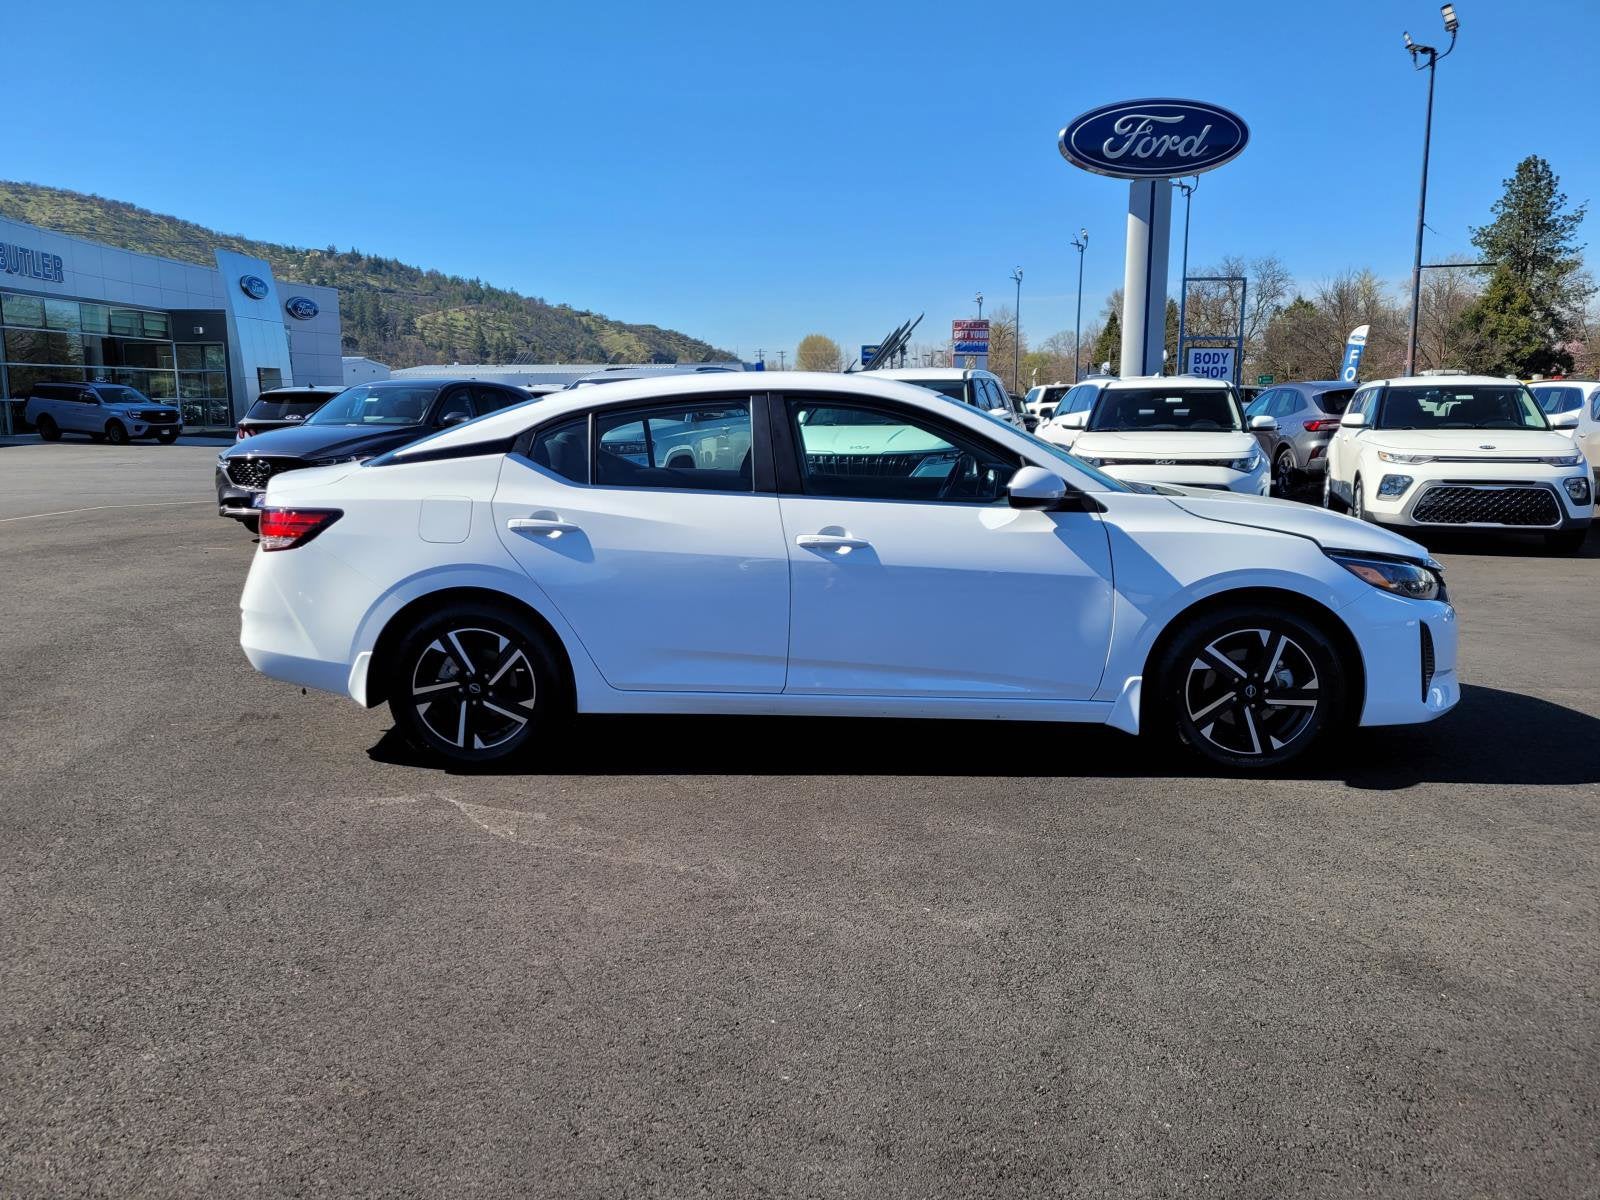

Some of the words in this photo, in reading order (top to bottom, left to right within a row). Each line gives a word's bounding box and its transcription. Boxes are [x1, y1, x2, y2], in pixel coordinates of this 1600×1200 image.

[1103, 114, 1212, 159] Ford
[1194, 352, 1229, 365] BODY
[1193, 366, 1228, 378] SHOP
